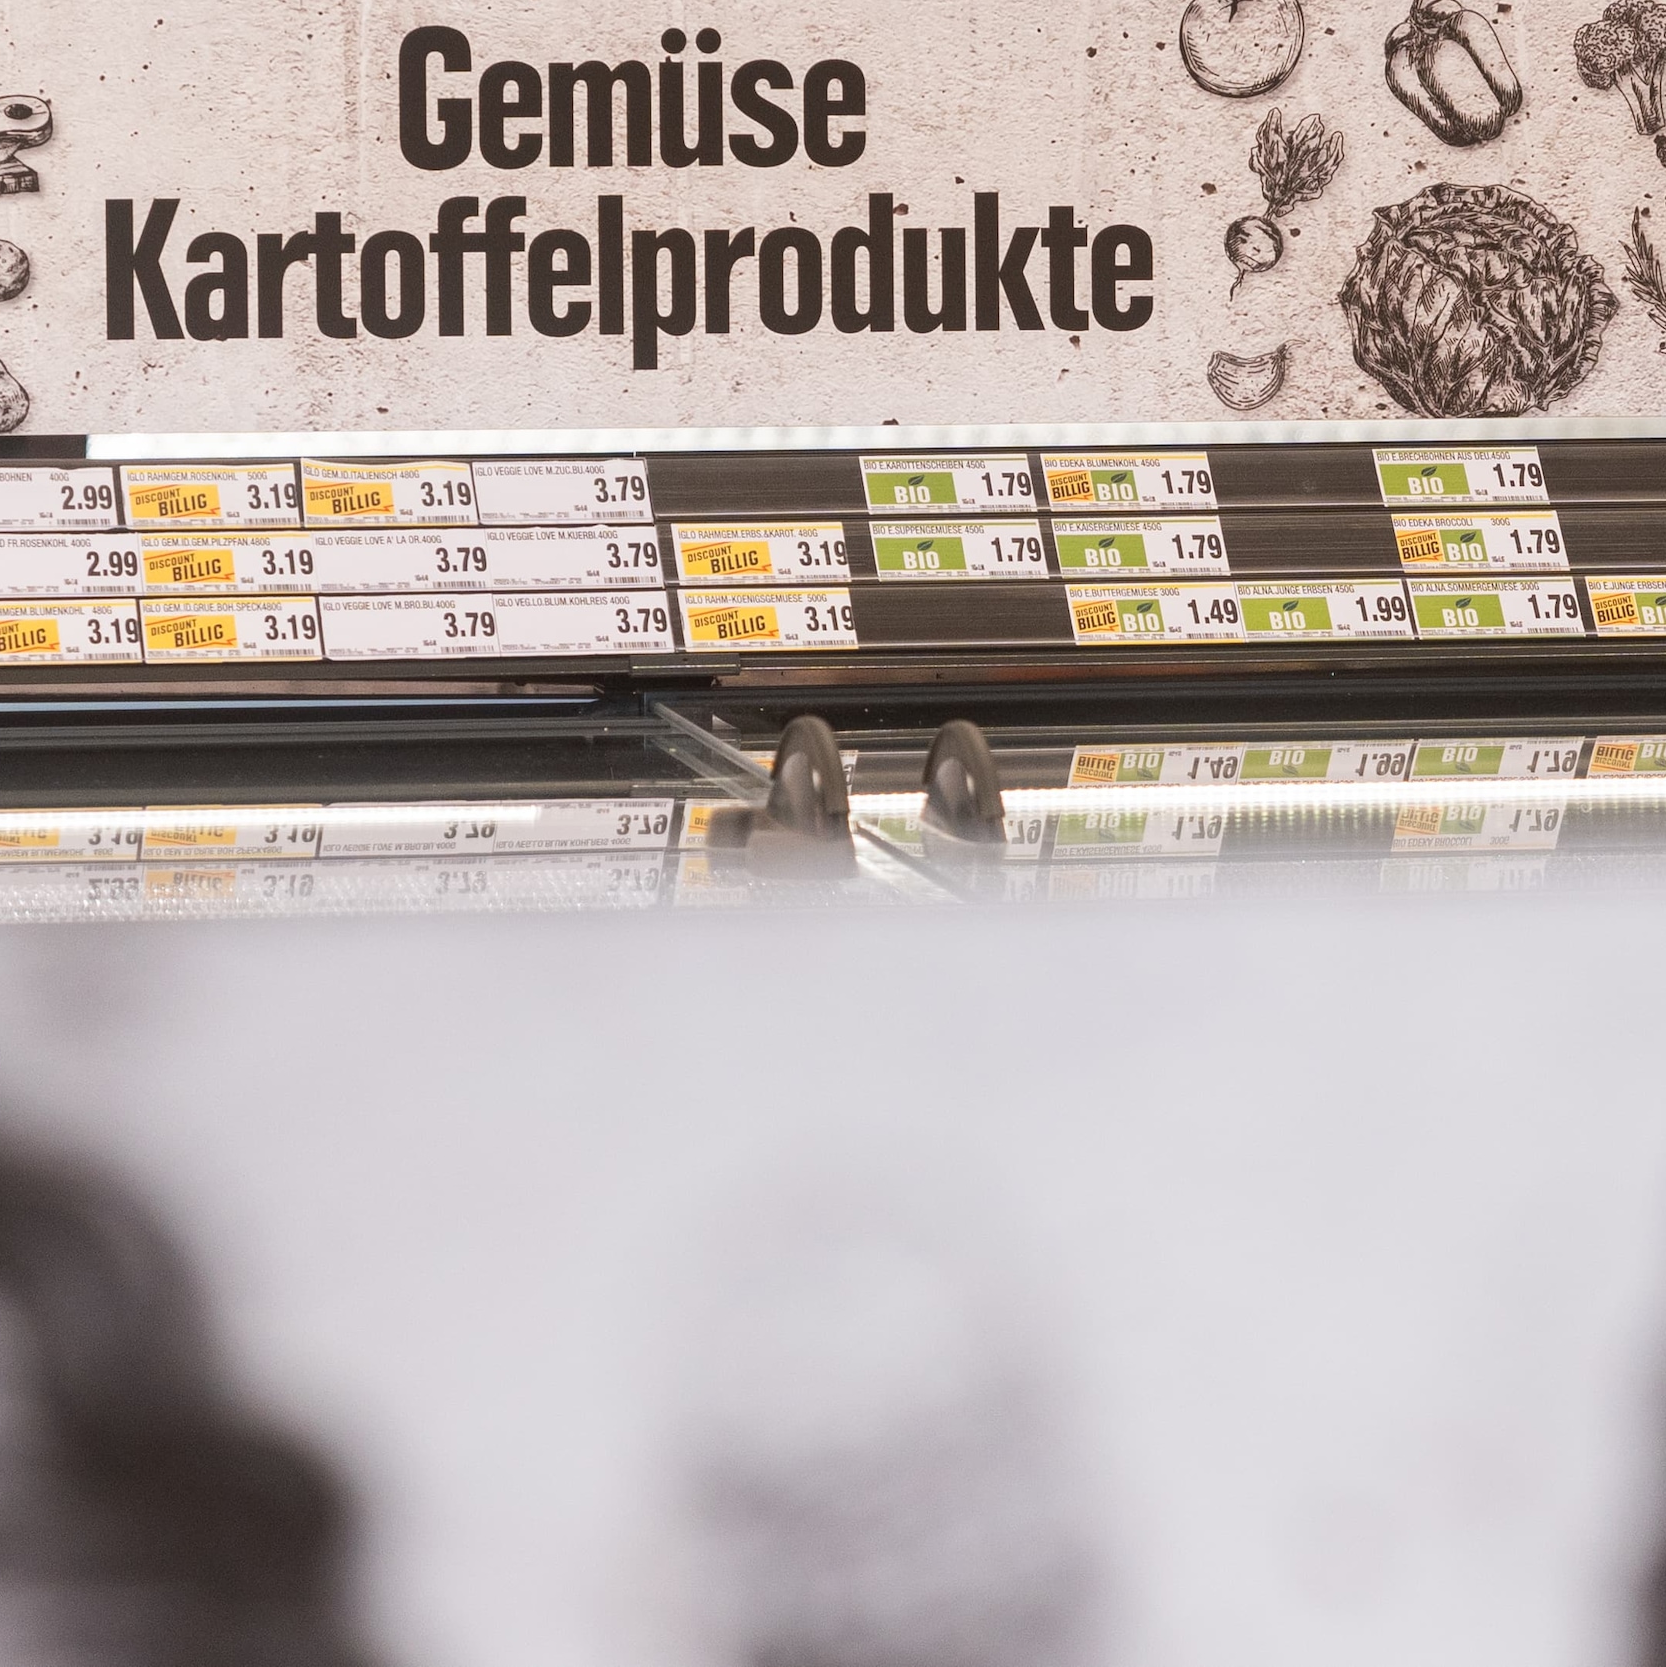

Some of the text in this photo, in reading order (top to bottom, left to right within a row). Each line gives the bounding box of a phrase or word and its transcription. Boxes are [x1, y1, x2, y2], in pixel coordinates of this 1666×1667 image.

[398, 25, 866, 170] Gemüse
[106, 191, 1153, 370] Kartoffelprodukte
[982, 472, 1031, 496] 1.79
[1050, 474, 1088, 487] DISCOUNT
[1162, 470, 1211, 493] 1.79
[1408, 477, 1443, 494] BIO
[1493, 464, 1543, 488] 1.79
[62, 485, 112, 509] 2.99
[135, 489, 180, 505] DISCOUNT
[247, 484, 297, 510] 3.19
[310, 487, 355, 502] DISCOUNT
[421, 481, 471, 506] 3.19
[595, 476, 645, 502] 3.79
[894, 485, 930, 503] BIO
[1053, 481, 1091, 498] BILLIG
[1096, 483, 1132, 501] BIO
[159, 494, 207, 517] BILLIG
[333, 492, 381, 514] BILLIG
[991, 538, 1041, 562] 1.79
[1172, 534, 1222, 558] 1.79
[1400, 534, 1437, 548] DISCOUNT
[1402, 541, 1440, 560] BILLIG
[1446, 543, 1483, 561] BIO
[1510, 530, 1560, 553] 1.79
[87, 551, 137, 576] 2.99
[150, 554, 195, 570] DISCOUNT
[263, 550, 313, 575] 3.19
[436, 547, 486, 572] 3.79
[607, 542, 657, 568] 3.79
[688, 545, 731, 562] DISCOUNT
[711, 552, 759, 574] BILLIG
[797, 540, 846, 567] 3.19
[903, 551, 938, 569] BIO
[1085, 548, 1121, 566] BIO
[173, 558, 221, 581] BILLIG
[1076, 605, 1114, 618] DISCOUNT
[1188, 599, 1238, 624] 1.49
[1356, 597, 1406, 621] 1.99
[1528, 595, 1578, 619] 1.79
[1596, 596, 1632, 610] DISCOUNT
[1598, 604, 1635, 623] BILLIG
[152, 619, 196, 635] DISCOUNT
[265, 615, 316, 640] 3.19
[444, 612, 495, 637] 3.79
[616, 608, 667, 633] 3.79
[695, 611, 738, 628] DISCOUNT
[718, 617, 765, 639] BILLIG
[805, 606, 853, 631] 3.19
[1078, 612, 1116, 630] BILLIG
[1123, 613, 1158, 630] BIO
[1269, 612, 1305, 630] BIO
[1442, 608, 1477, 626] BIO
[88, 619, 139, 644] 3.19
[175, 624, 223, 648] BILLIG
